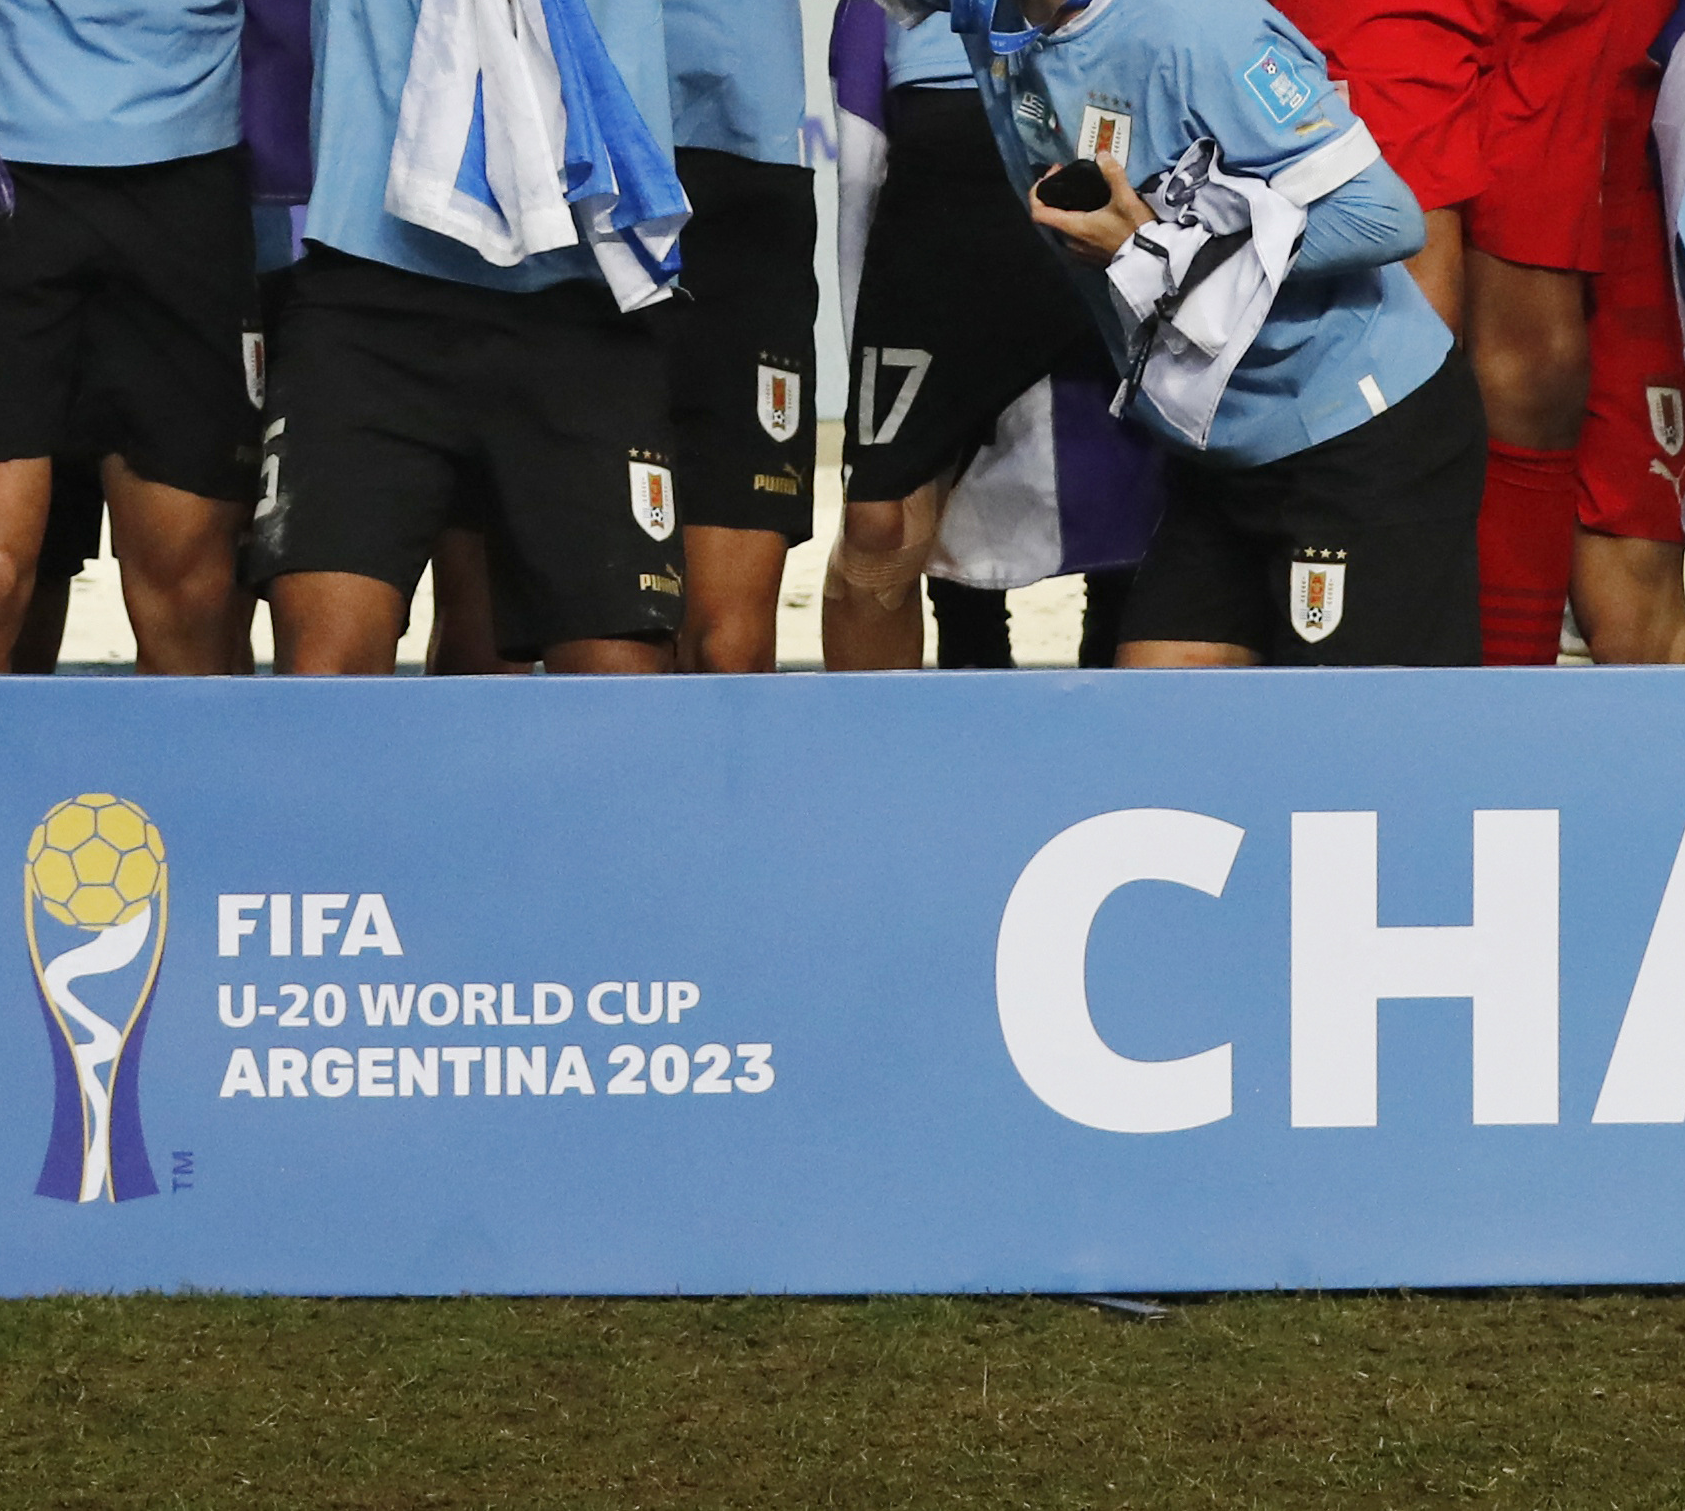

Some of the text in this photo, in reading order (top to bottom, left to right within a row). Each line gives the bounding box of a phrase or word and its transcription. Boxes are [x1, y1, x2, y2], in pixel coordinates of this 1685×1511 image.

[858, 346, 934, 445] 17
[218, 893, 404, 957] FIFA
[219, 980, 701, 1029] U-20 WORLD CUP
[219, 1043, 776, 1099] ARGENTINA 2023
